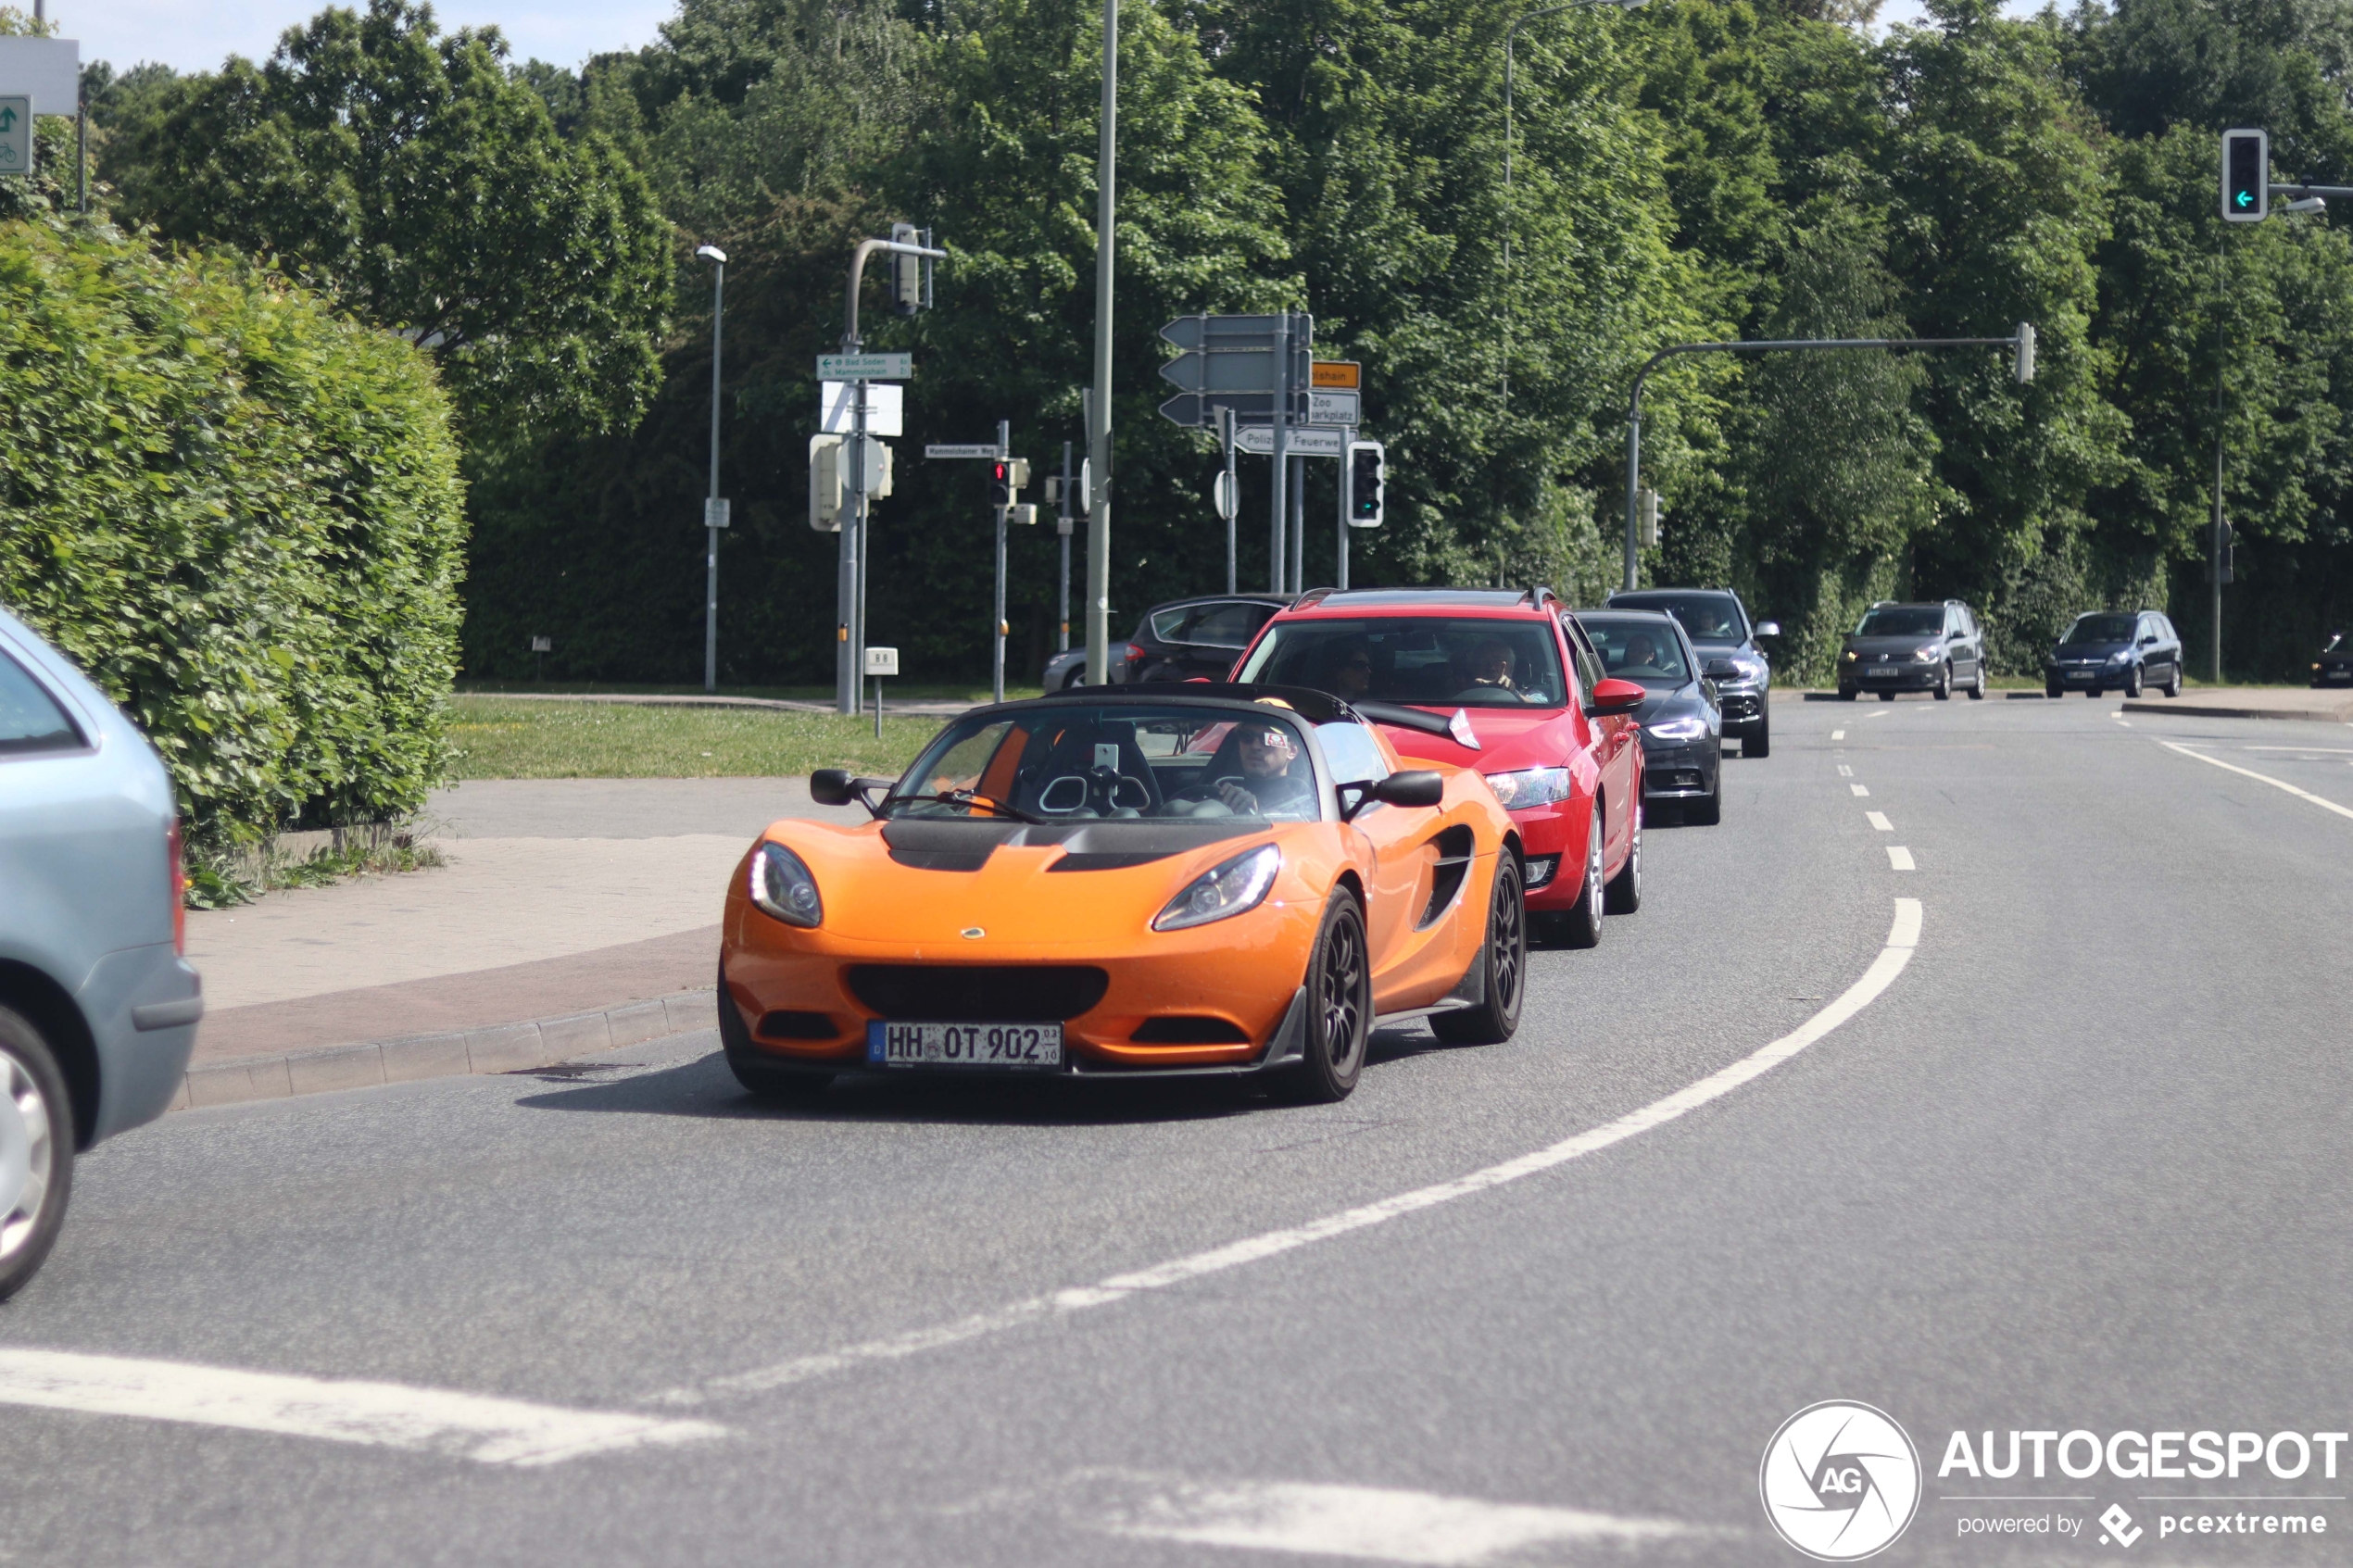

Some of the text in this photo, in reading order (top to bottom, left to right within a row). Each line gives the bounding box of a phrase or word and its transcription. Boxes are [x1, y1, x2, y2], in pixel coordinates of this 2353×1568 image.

[845, 358, 860, 366] Bad
[862, 358, 886, 366] Soden
[835, 368, 887, 376] Mammolshain
[1313, 397, 1331, 408] Zoo
[1294, 435, 1339, 447] Feuerwe
[981, 447, 995, 458] Weg
[1044, 1029, 1057, 1038] 03
[887, 1026, 923, 1058] HH
[944, 1026, 980, 1059] OT
[988, 1028, 1040, 1060] 902
[1044, 1050, 1057, 1060] 10
